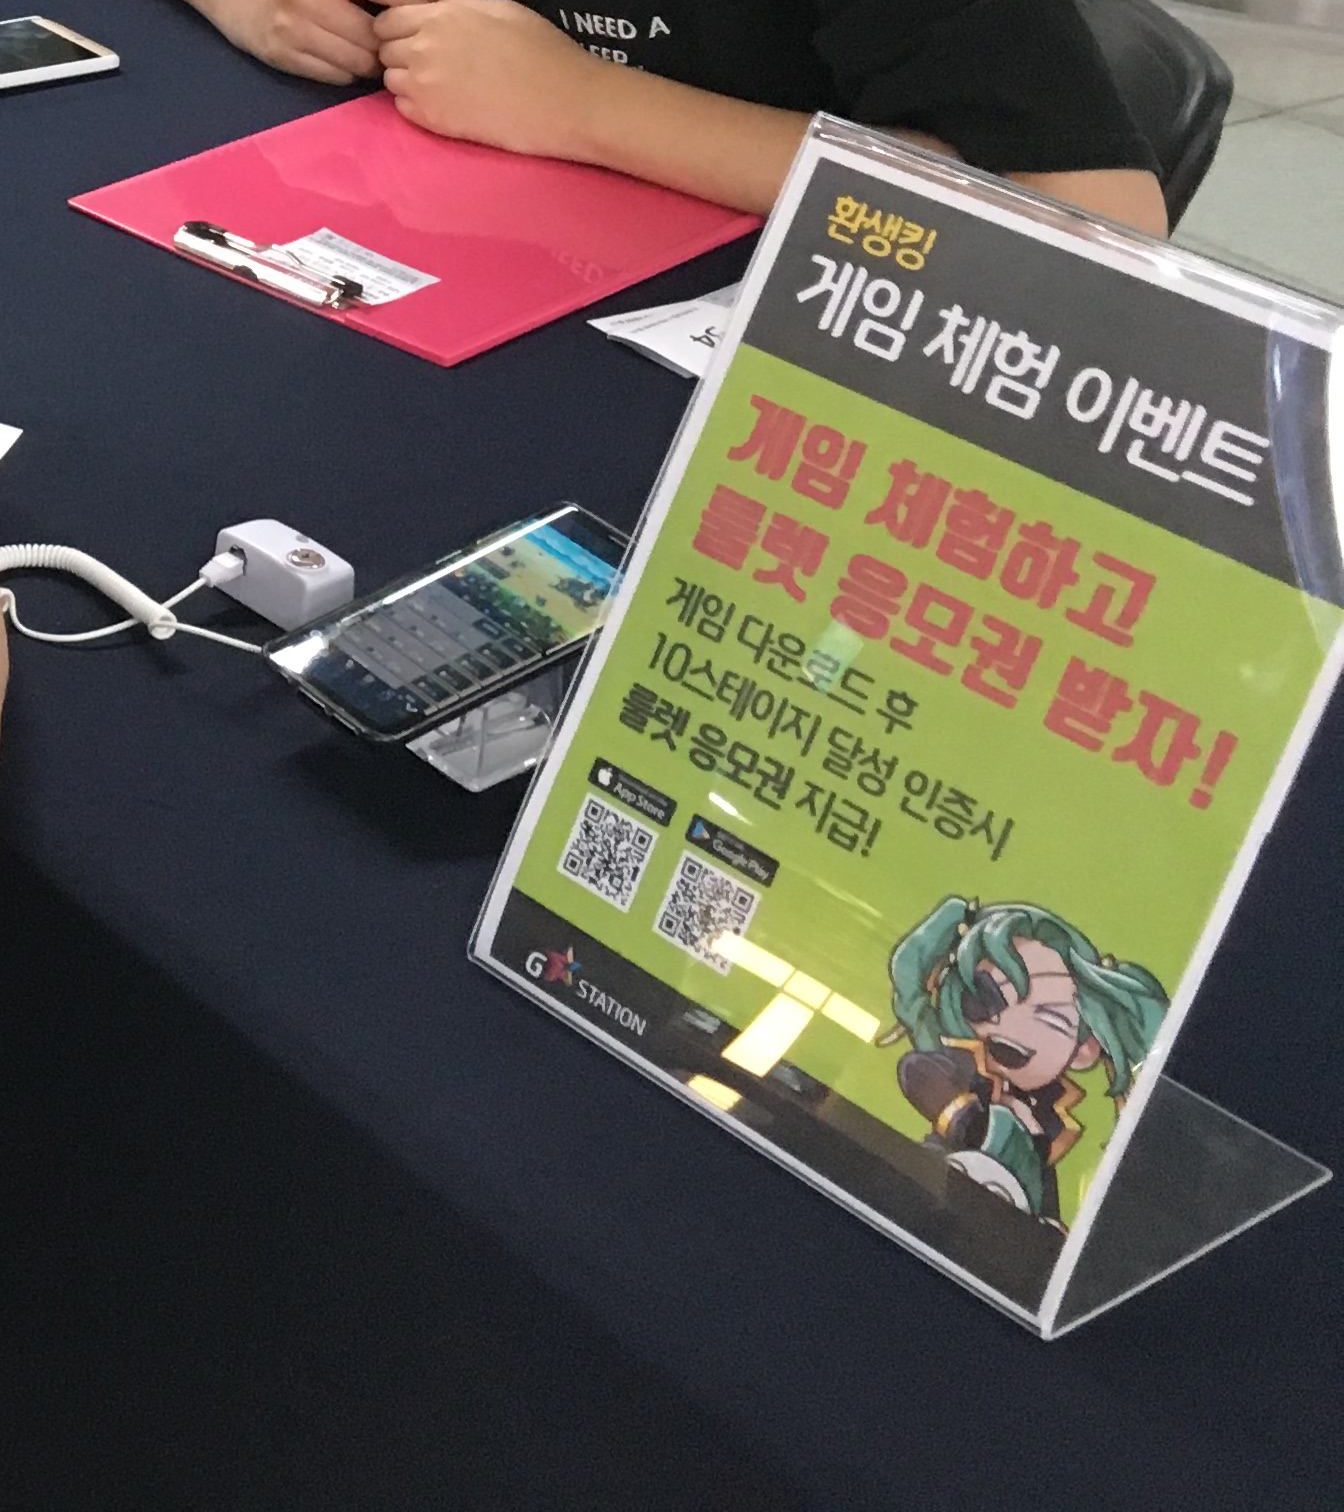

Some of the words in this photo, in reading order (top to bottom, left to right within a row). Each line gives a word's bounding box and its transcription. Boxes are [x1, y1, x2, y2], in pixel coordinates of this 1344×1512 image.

[559, 9, 570, 30] I
[573, 11, 638, 40] NEED
[648, 16, 671, 39] A
[827, 195, 938, 271] 환생킹
[796, 254, 924, 363] 게임
[923, 303, 1061, 420] 체험
[1065, 365, 1271, 507] 이벤트
[726, 393, 868, 509] 게임
[864, 457, 1156, 648] 체험하고
[665, 576, 737, 643] 게임
[737, 614, 876, 714] 다운로드
[875, 687, 920, 732] 후
[692, 483, 831, 602] 룰렛
[830, 553, 1044, 709] 응모권
[1043, 655, 1239, 810] 받자!
[613, 782, 638, 803] App
[636, 793, 666, 821] Store
[618, 682, 691, 752] 룰렛
[688, 722, 796, 811] 응모권
[794, 785, 883, 857] 지급!
[648, 631, 823, 758] 10스테이지
[825, 725, 900, 798] 달성
[904, 769, 1015, 862] 인증시
[523, 951, 548, 978] G
[574, 978, 648, 1037] STATION
